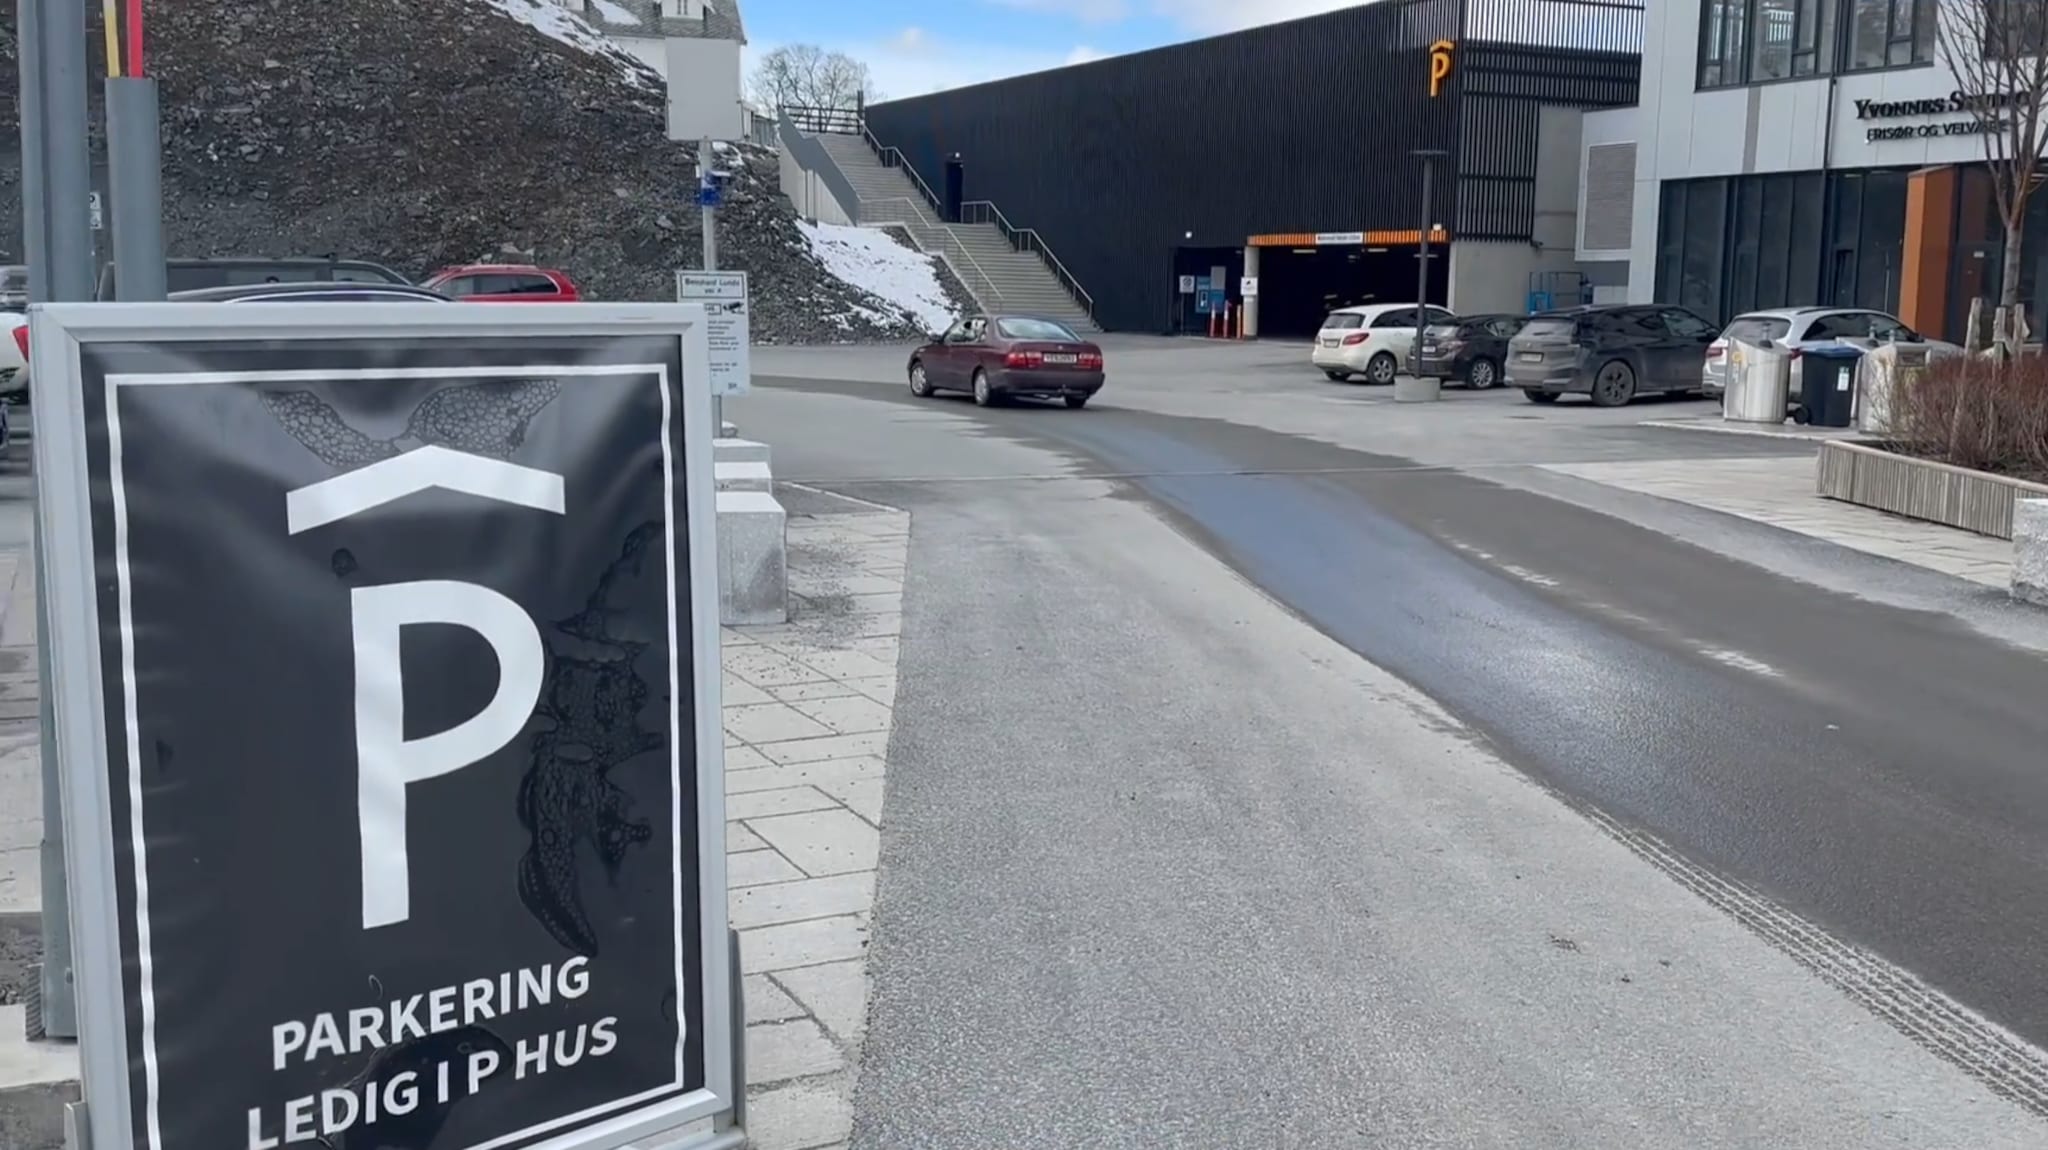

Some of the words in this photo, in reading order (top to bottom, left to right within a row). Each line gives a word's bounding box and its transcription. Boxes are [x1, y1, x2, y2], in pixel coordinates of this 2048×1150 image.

[1431, 52, 1450, 97] P
[1854, 98, 1945, 120] YVONNES
[1867, 126, 1913, 141] FRISØR
[1918, 124, 1939, 138] OG
[351, 579, 545, 930] P
[272, 955, 591, 1071] PARKERING
[247, 1070, 419, 1150] LEDIG
[437, 1061, 450, 1104] I
[467, 1048, 500, 1095] P
[514, 1016, 619, 1081] HUS
